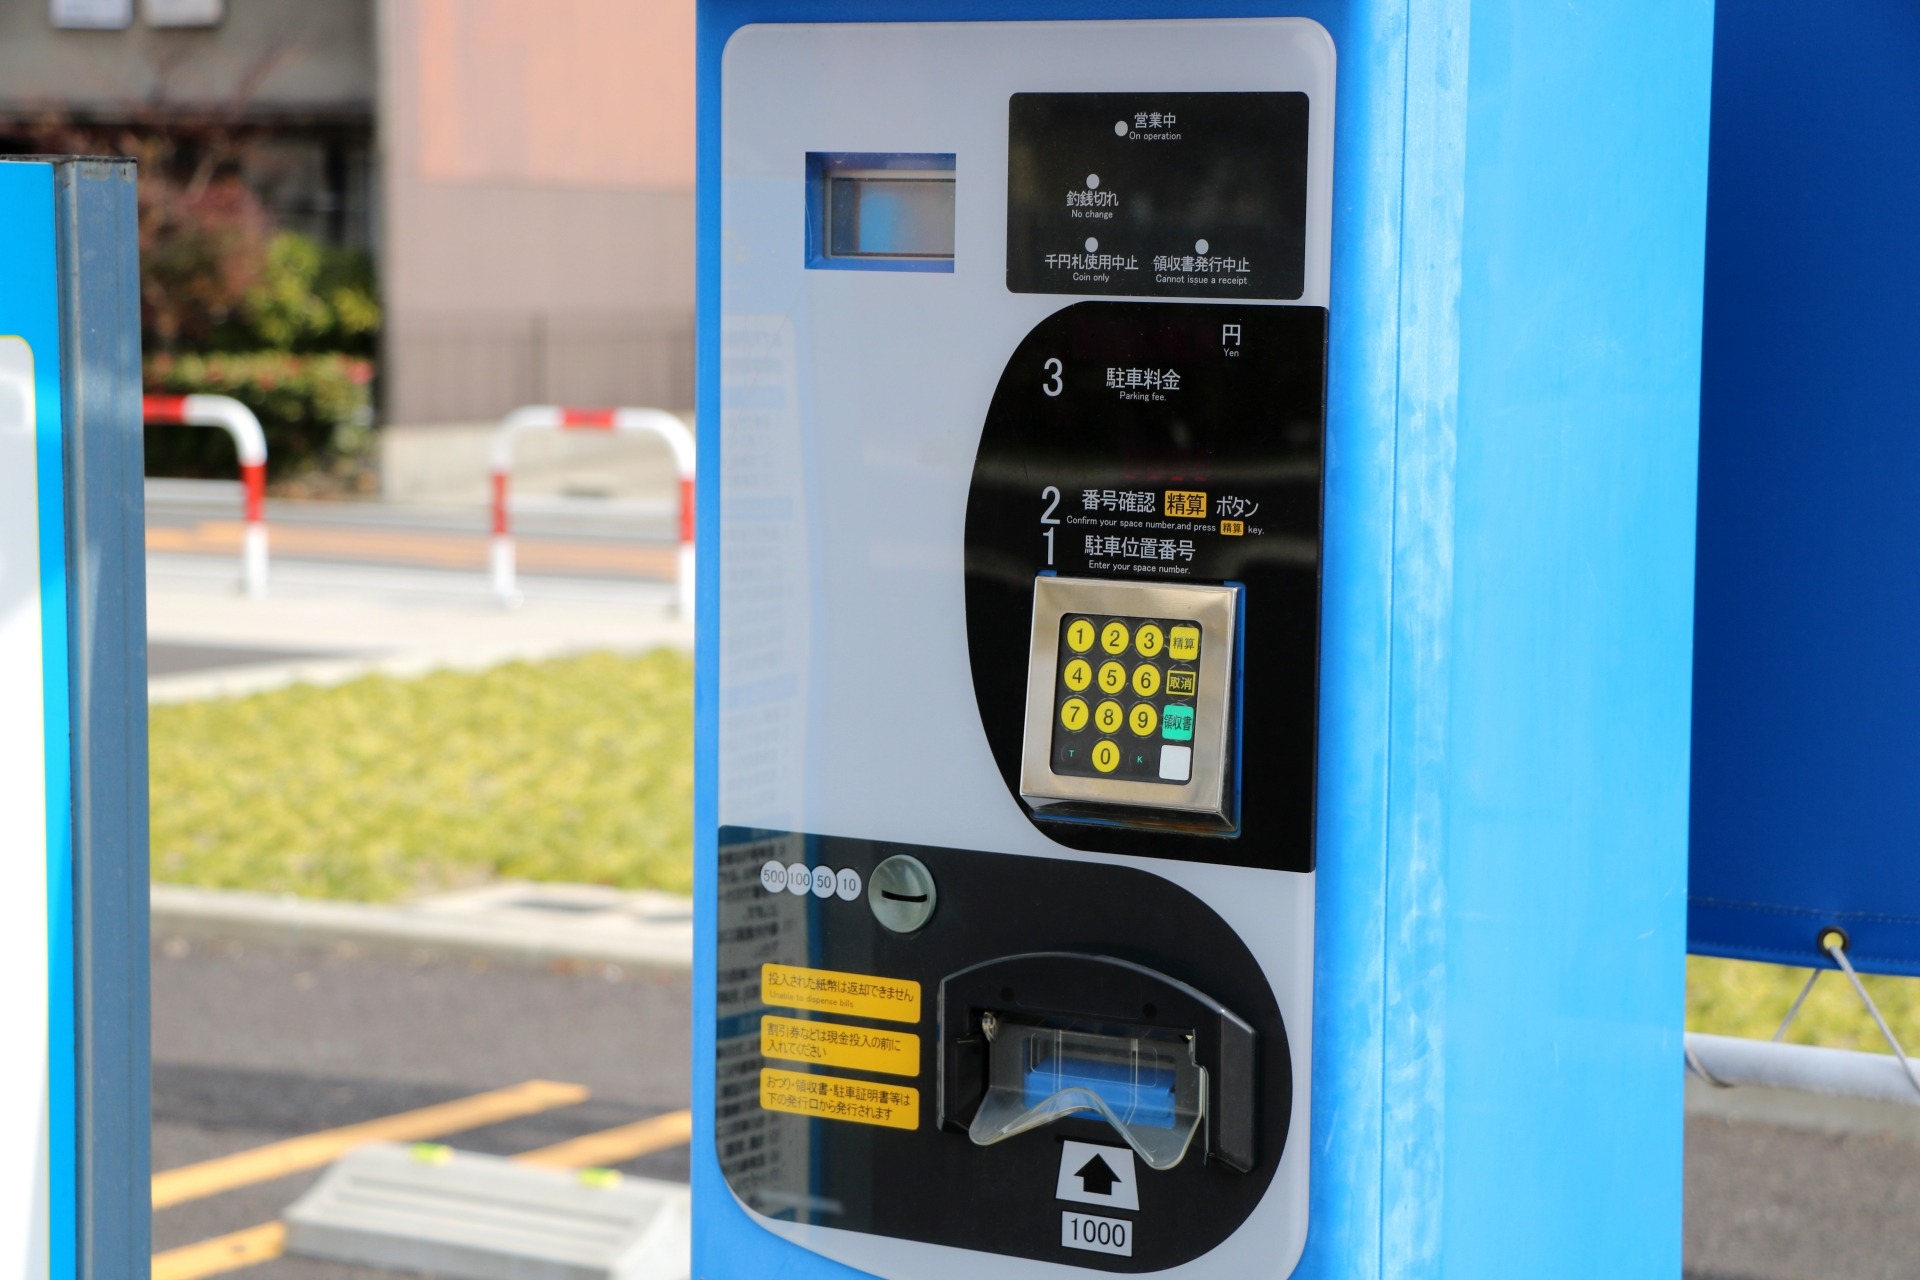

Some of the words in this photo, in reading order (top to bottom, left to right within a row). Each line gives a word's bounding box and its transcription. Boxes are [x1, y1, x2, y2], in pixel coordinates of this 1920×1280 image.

[1135, 112, 1176, 128] 営業中
[1129, 132, 1140, 140] On
[1143, 132, 1181, 140] operation
[1067, 191, 1119, 207] 釣銭切れ
[1072, 210, 1082, 218] No
[1085, 210, 1113, 219] change
[1045, 254, 1138, 270] 千円札使用中止
[1153, 256, 1250, 273] 領収書発行中止
[1073, 273, 1091, 281] Coin
[1094, 273, 1109, 282] only
[1156, 275, 1184, 284] Cannot
[1187, 276, 1207, 285] issue
[1219, 276, 1247, 286] receipt
[1222, 324, 1241, 346] 円
[1224, 349, 1239, 357] Yen
[1043, 358, 1063, 397] 3
[1106, 368, 1181, 390] 駐車料金
[1120, 392, 1149, 402] Parking
[1152, 393, 1166, 401] fee.
[1040, 486, 1061, 524] 2
[1082, 489, 1155, 513] 番号確認
[1166, 493, 1205, 515] 精算
[1216, 496, 1259, 517] ボタン
[1067, 516, 1097, 525] Confirm
[1100, 519, 1117, 527] your
[1194, 524, 1216, 532] press
[1222, 523, 1242, 533] 精算
[1248, 526, 1264, 535] key.
[1043, 527, 1053, 565] 1
[1085, 535, 1195, 562] 駐車位置番号
[1089, 560, 1110, 569] Enter
[1113, 563, 1129, 571] your
[1133, 564, 1156, 572] space
[1159, 565, 1190, 574] number.
[1077, 628, 1083, 644] 1
[1110, 630, 1120, 647] 2
[1144, 633, 1154, 649] 3
[1173, 637, 1195, 650] 精算
[1072, 668, 1083, 683] 4
[1106, 670, 1117, 686] 5
[1141, 672, 1151, 688] 6
[1169, 676, 1191, 690] 取消
[1070, 707, 1080, 722] 7
[1103, 709, 1114, 725] 8
[1138, 712, 1148, 728] 9
[1164, 715, 1192, 730] 領収書
[1101, 748, 1111, 764] 0
[763, 870, 785, 883] 500
[789, 872, 810, 886] 100
[817, 875, 831, 889] 50
[843, 878, 856, 891] 10
[769, 972, 913, 1001] 投入された紙幣は返却できません
[770, 991, 793, 999] Unable
[806, 995, 837, 1006] dispense
[840, 999, 853, 1007] bills
[768, 1022, 901, 1051] 割引券などは現金投入の前に
[768, 1039, 826, 1058] 入れてください
[768, 1092, 892, 1120] 下の発行口から発行されます
[1071, 1218, 1125, 1247] 1000
